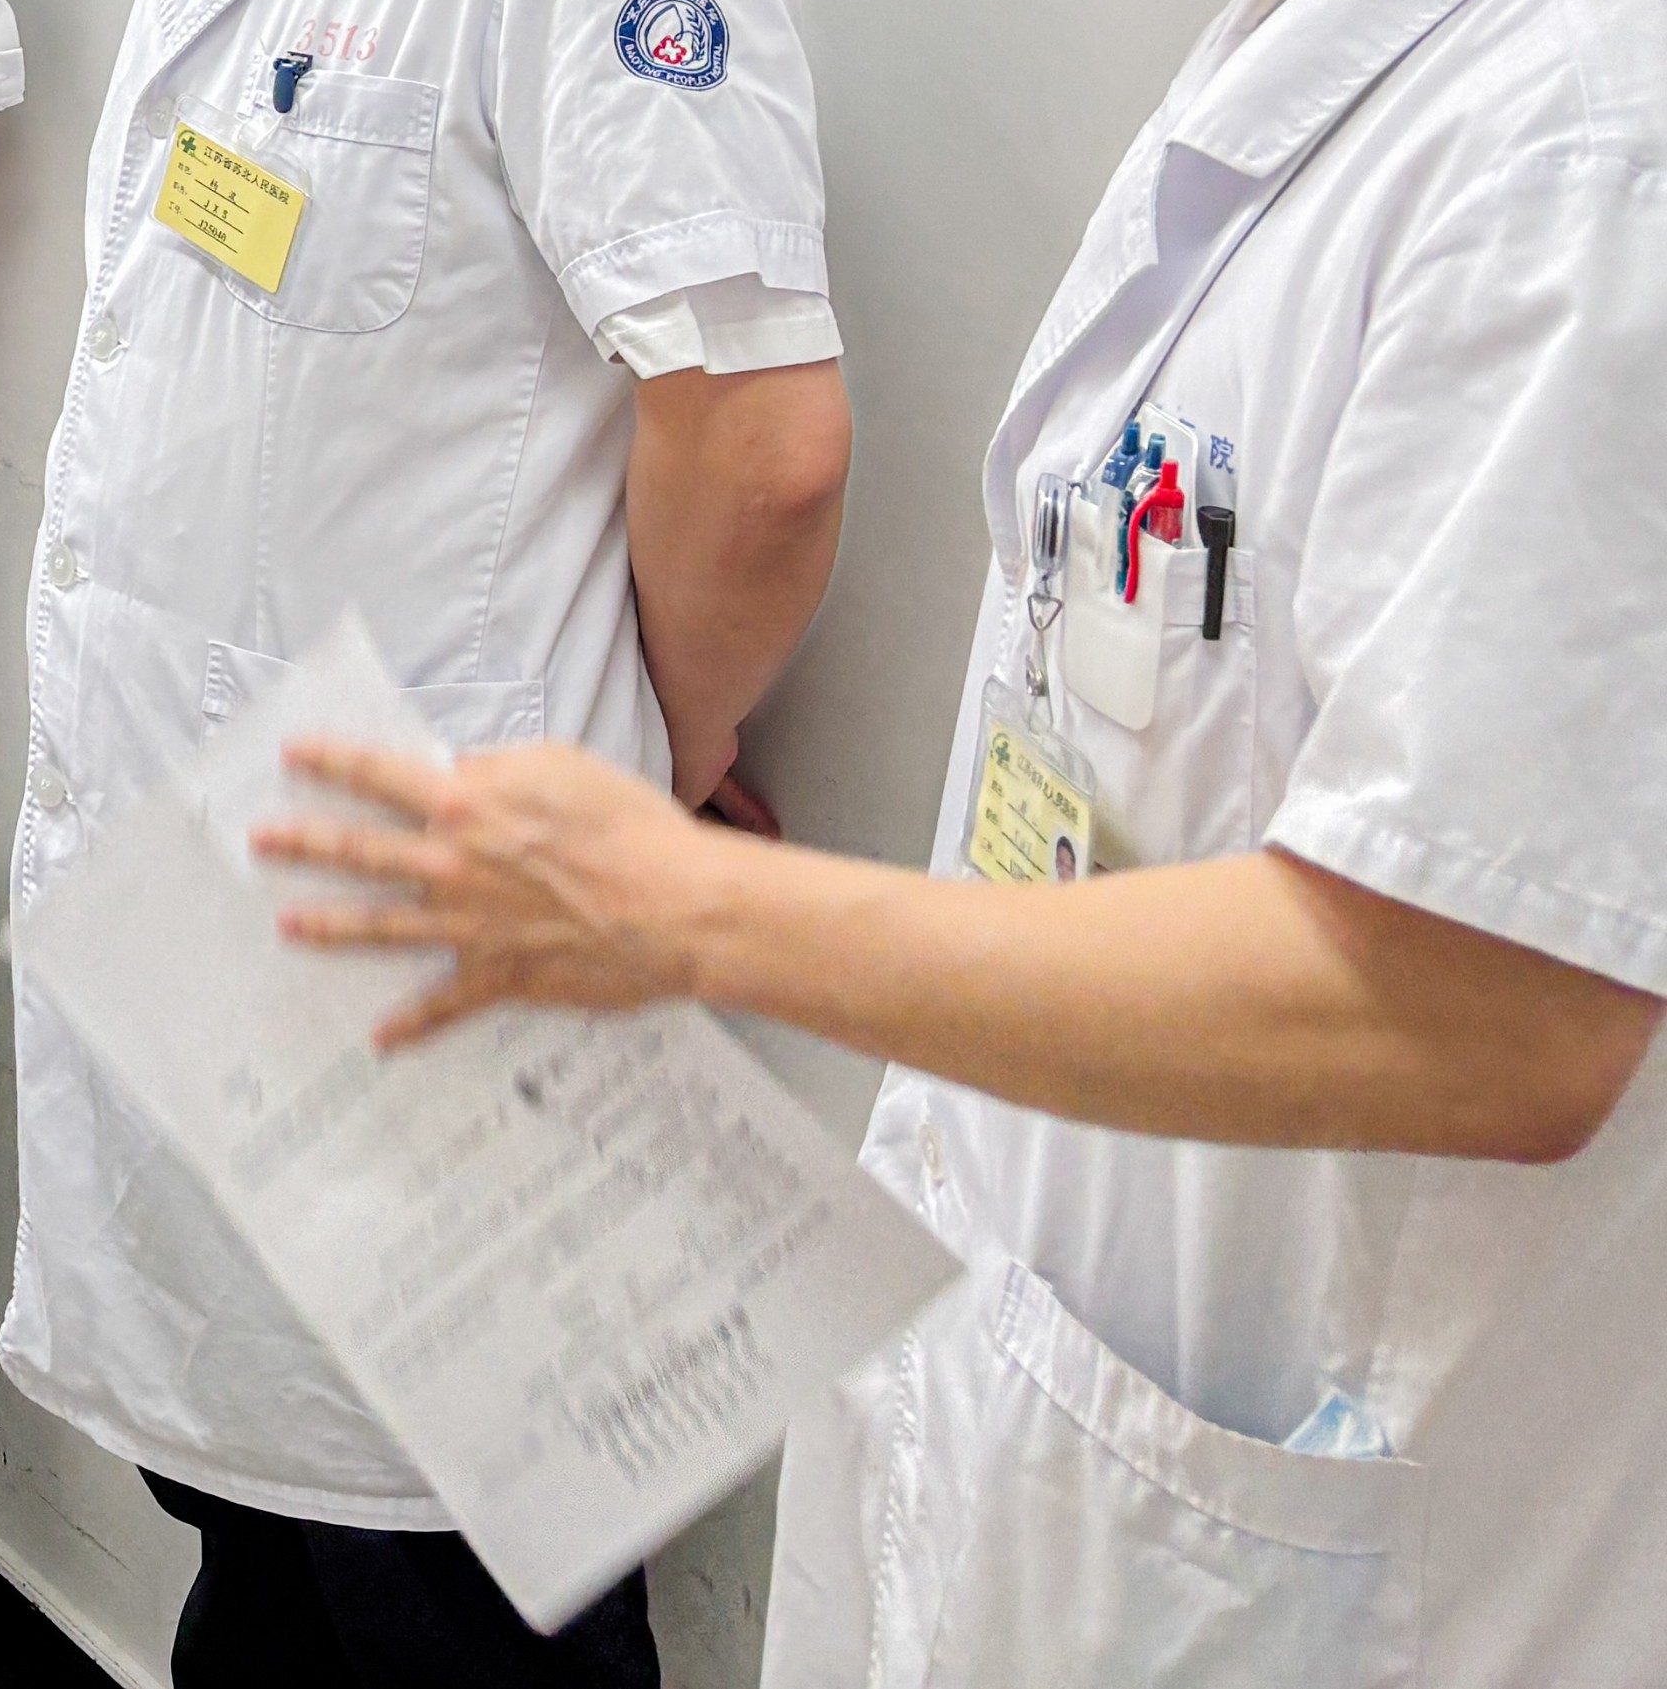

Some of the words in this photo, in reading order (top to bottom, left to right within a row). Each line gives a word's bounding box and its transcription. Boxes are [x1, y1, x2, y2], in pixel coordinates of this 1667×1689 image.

[295, 19, 378, 62] 3513
[204, 146, 290, 205] 江苏省苏北人民医院
